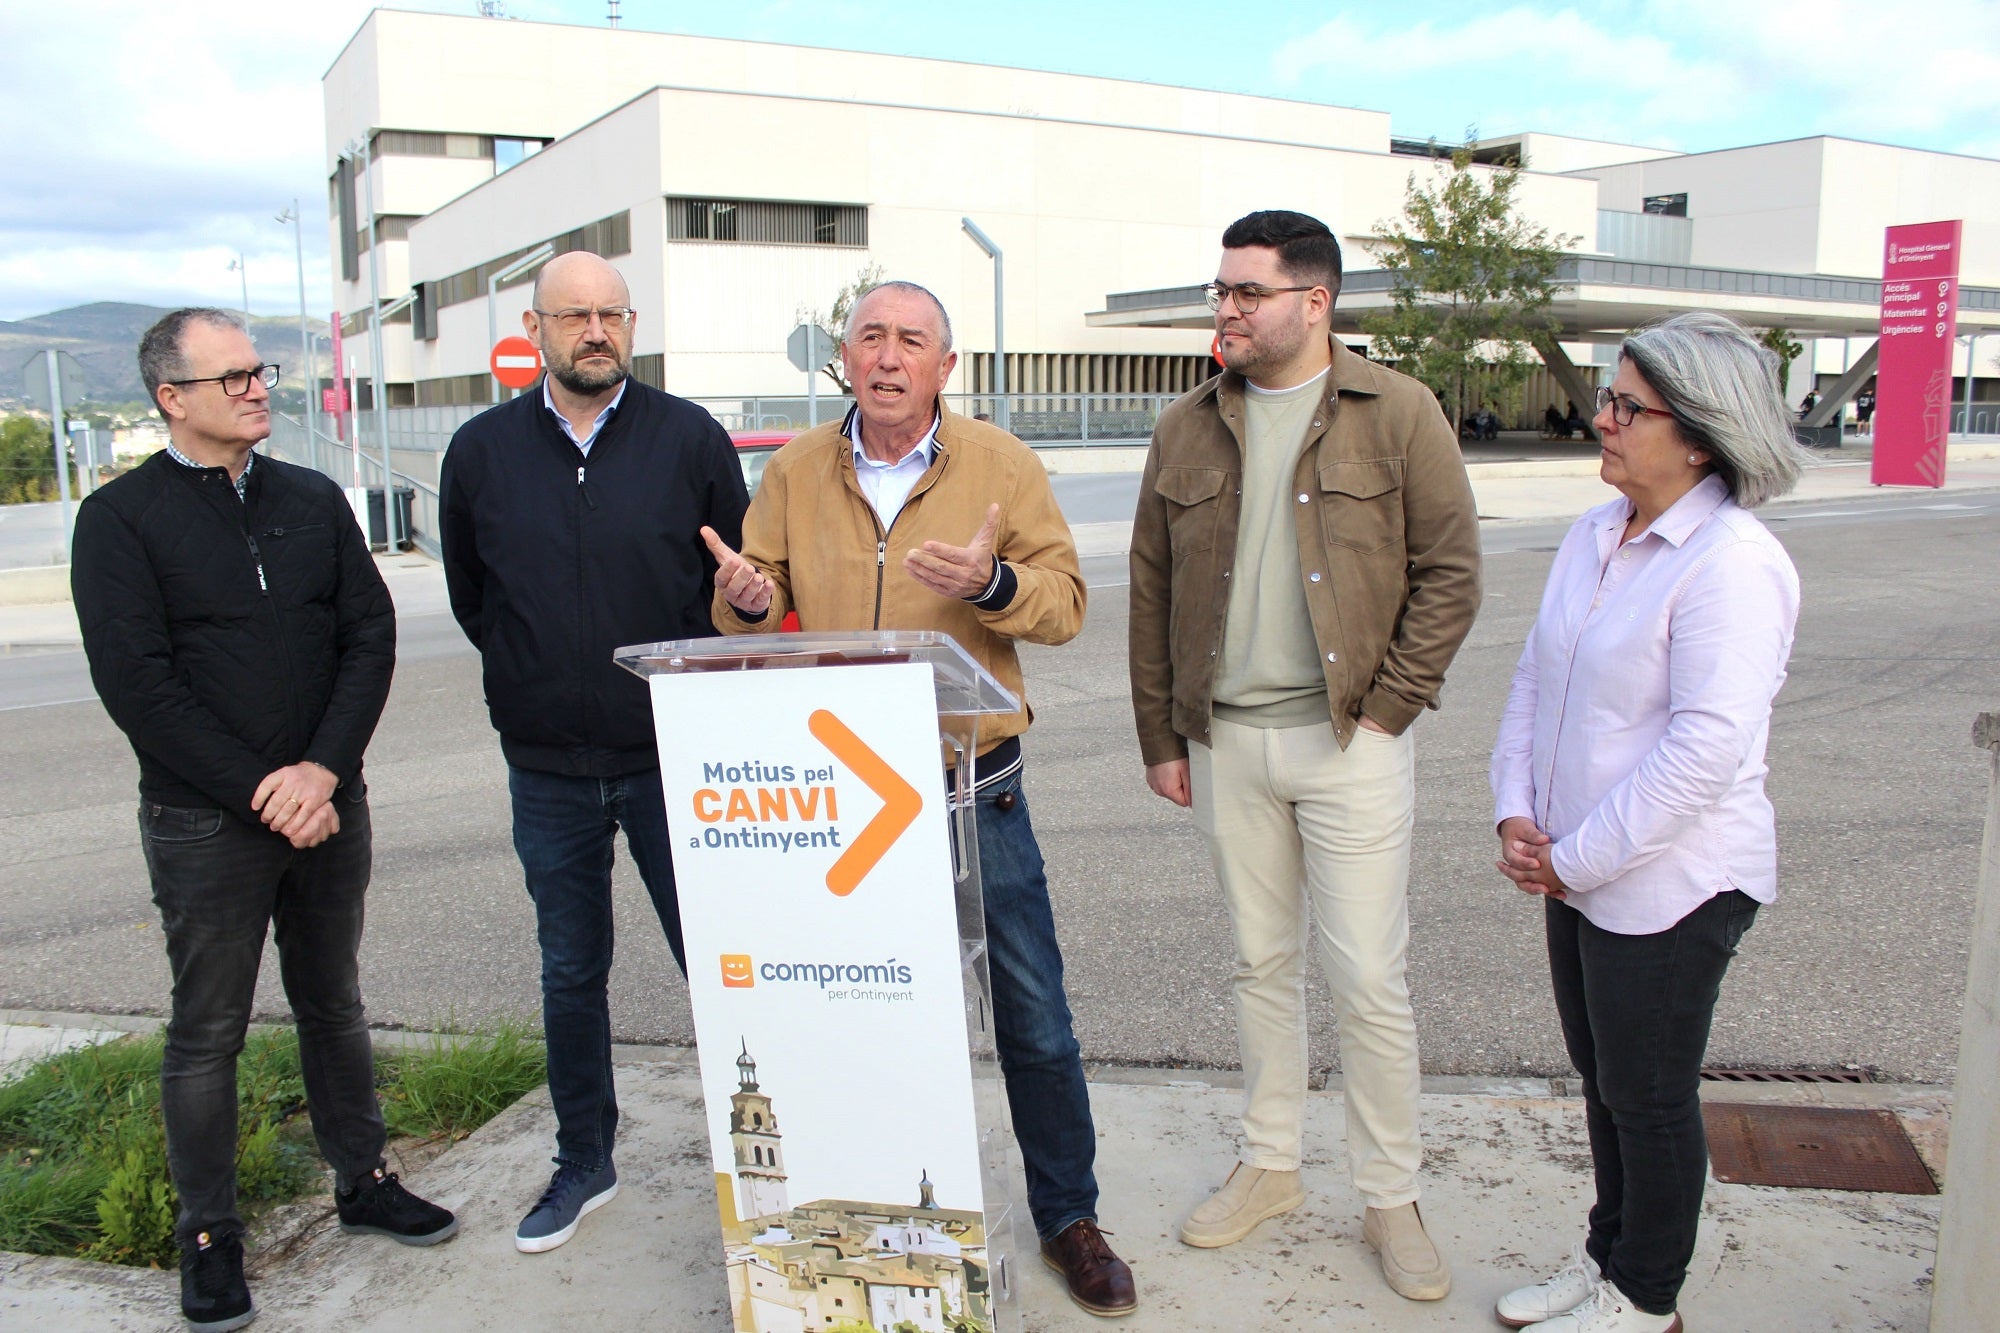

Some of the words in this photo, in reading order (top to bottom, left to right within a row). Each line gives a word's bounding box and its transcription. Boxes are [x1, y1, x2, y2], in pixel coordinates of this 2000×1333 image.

[1898, 246, 1925, 254] Hospital
[1925, 242, 1950, 252] General
[1884, 283, 1910, 292] Accés
[1883, 291, 1920, 304] principal
[1883, 308, 1926, 318] Maternitat
[703, 761, 796, 783] Motius
[804, 765, 834, 785] pel
[692, 787, 839, 823] CANVI
[689, 837, 700, 849] a
[703, 826, 841, 853] Ontinyent
[760, 958, 913, 989] compromís
[828, 989, 848, 1002] per
[850, 988, 914, 1003] Ontinyent
